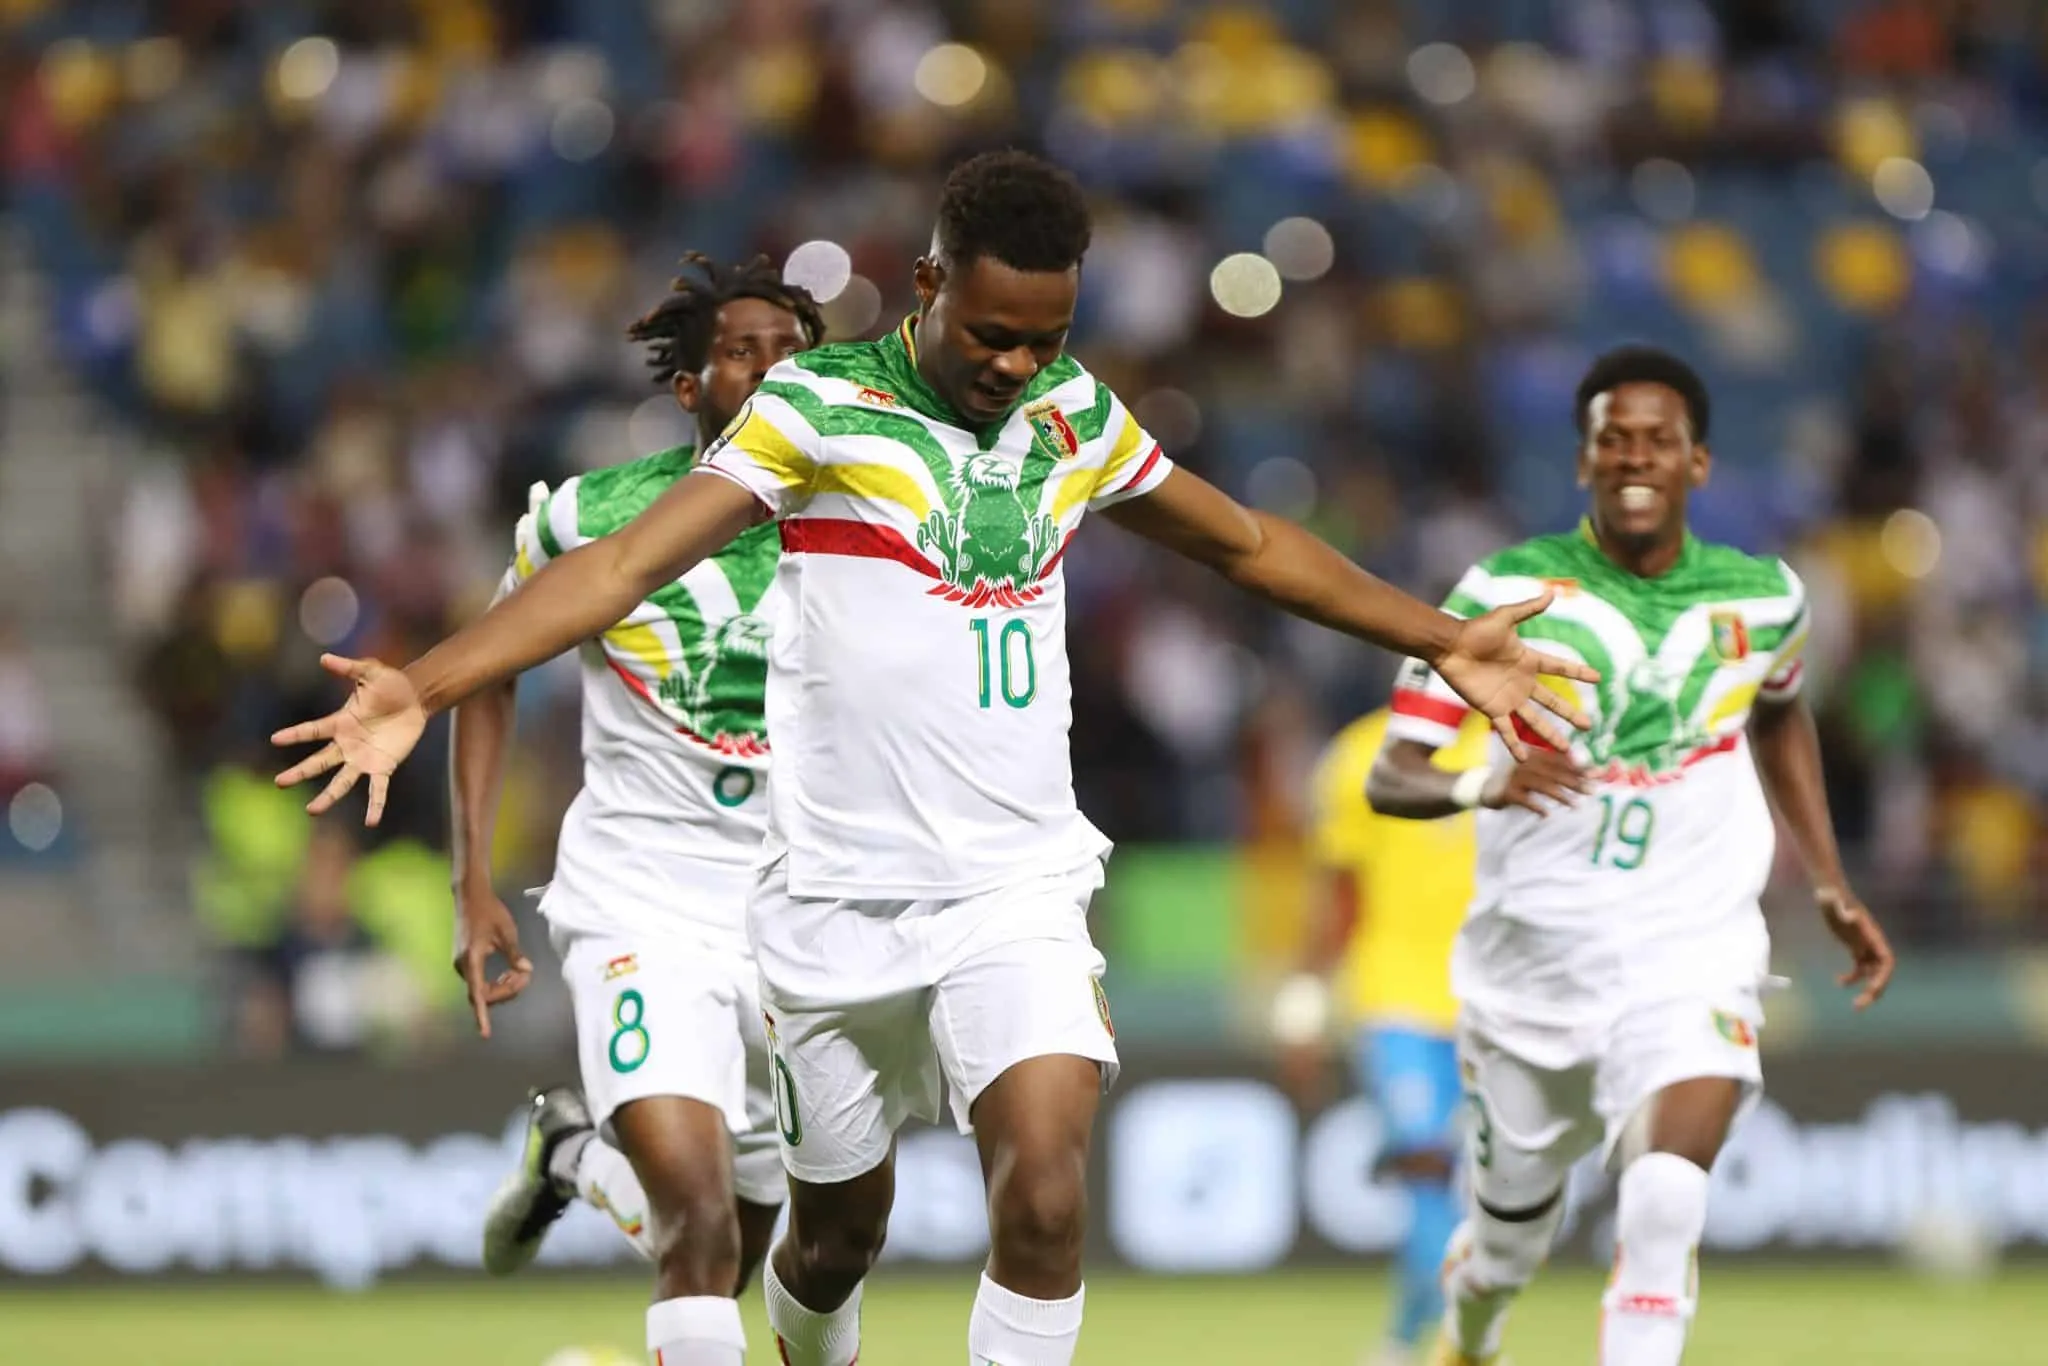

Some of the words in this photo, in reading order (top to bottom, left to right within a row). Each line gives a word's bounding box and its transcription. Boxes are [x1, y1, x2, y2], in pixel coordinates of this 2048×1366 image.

[969, 618, 1038, 709] 10
[1592, 794, 1655, 870] 19
[608, 988, 650, 1073] 8
